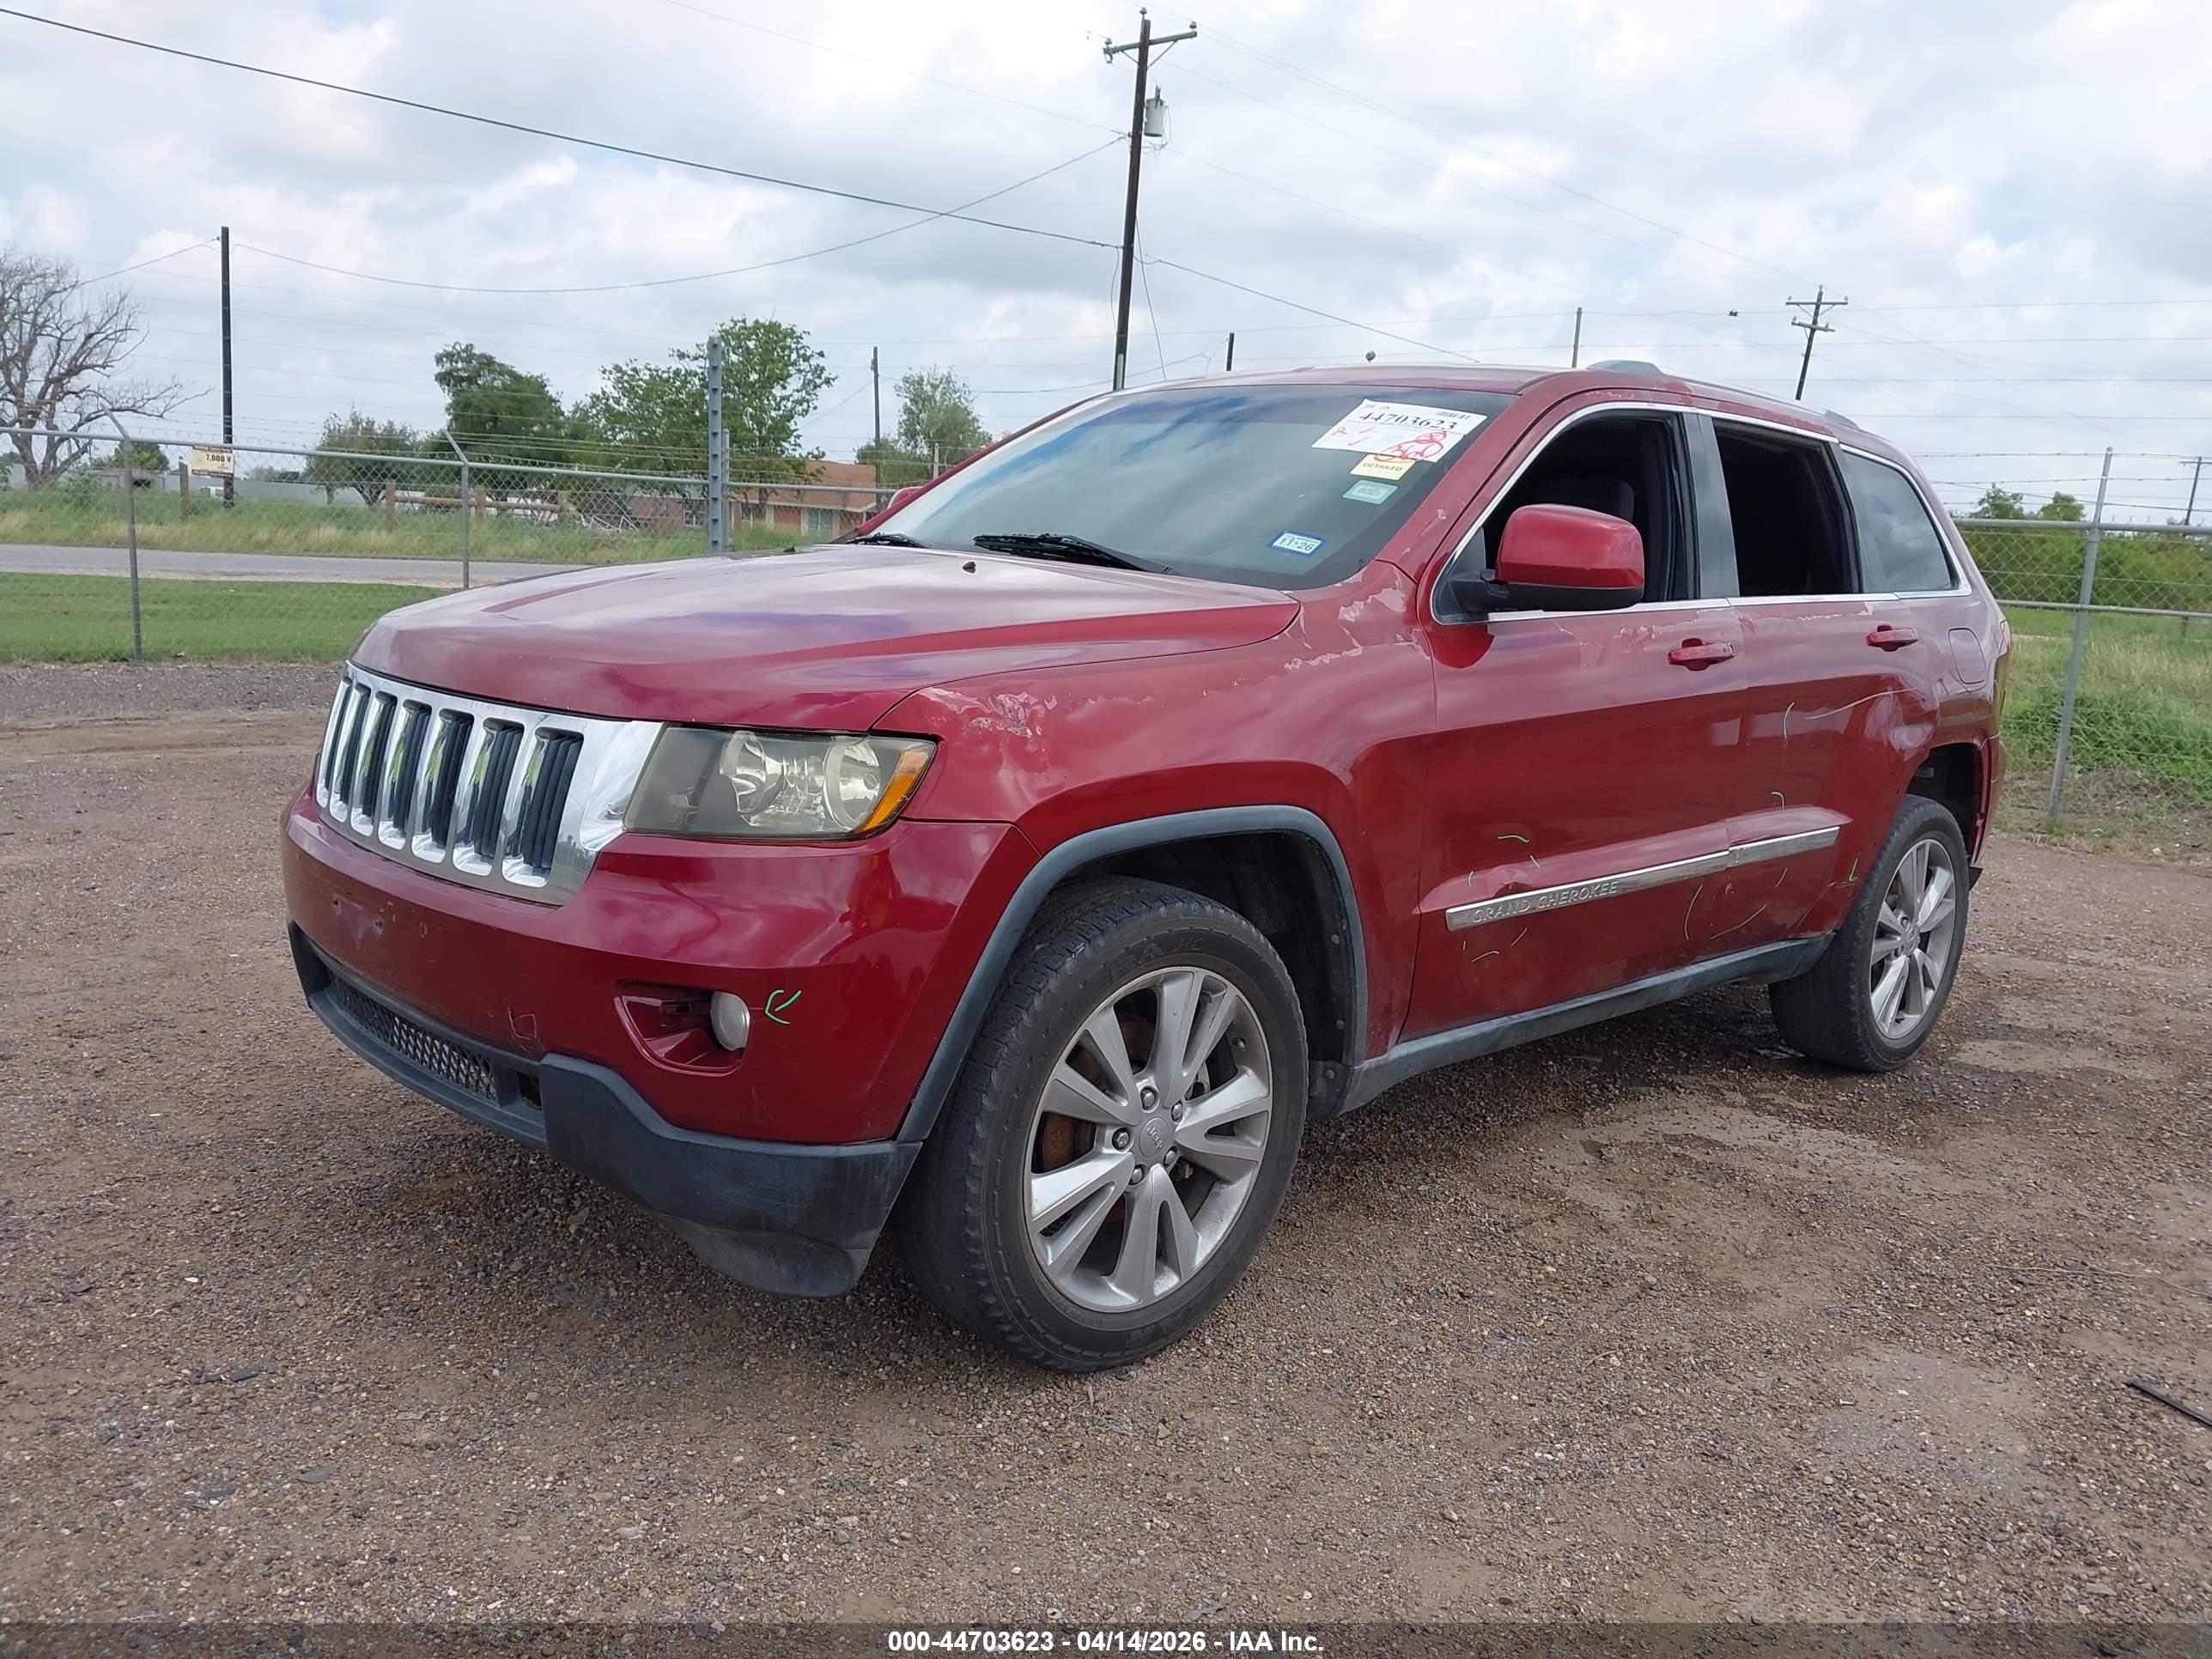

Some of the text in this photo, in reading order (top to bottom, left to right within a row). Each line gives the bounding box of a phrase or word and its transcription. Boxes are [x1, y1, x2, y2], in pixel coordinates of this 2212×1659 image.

[1358, 411, 1458, 430] 44703623
[206, 453, 225, 462] 7,000
[1362, 462, 1403, 471] DETAILED
[1472, 881, 1619, 923] GRAND CHEROKEE
[1146, 1126, 1164, 1148] Jeep
